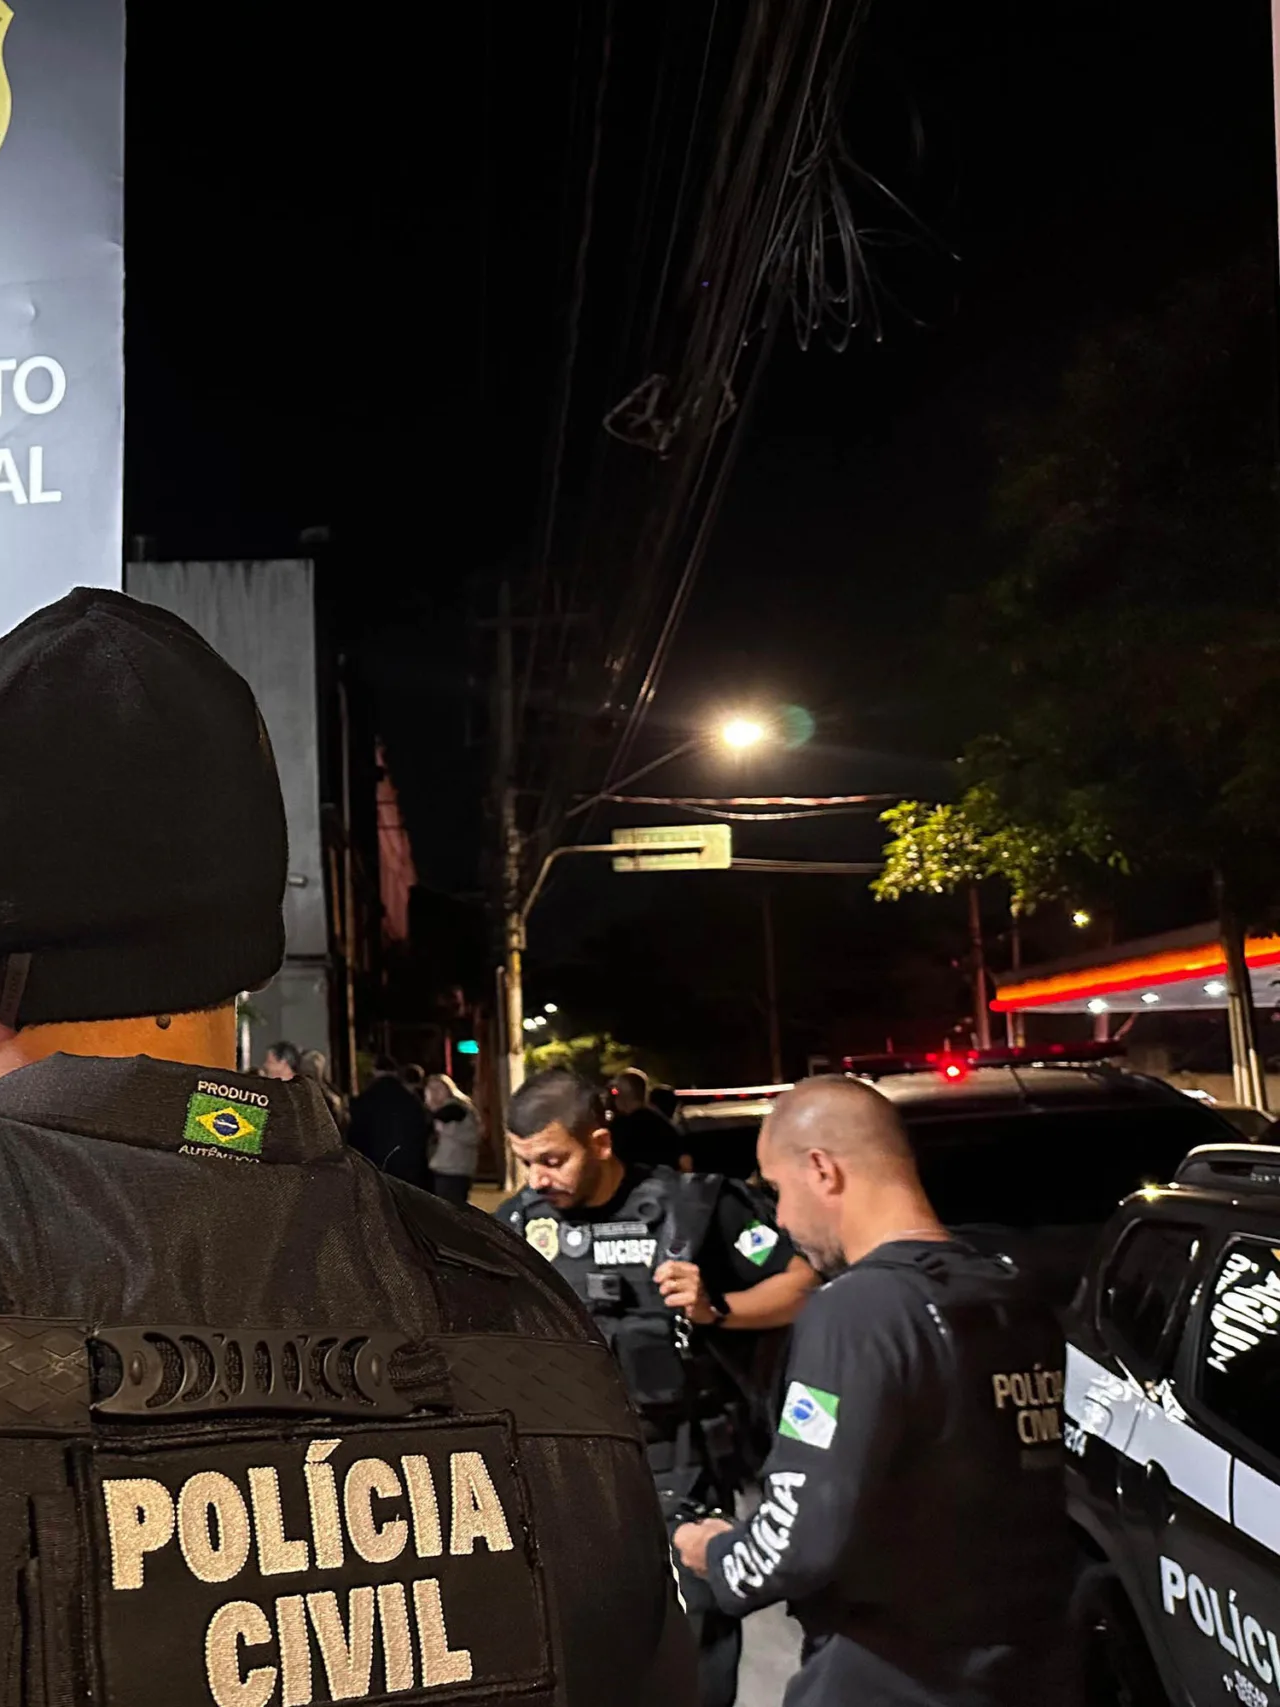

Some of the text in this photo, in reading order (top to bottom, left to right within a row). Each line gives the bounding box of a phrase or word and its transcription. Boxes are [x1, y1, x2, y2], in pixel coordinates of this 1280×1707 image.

[197, 1080, 269, 1107] PRODUTO
[102, 1438, 514, 1590] POLÍCIA
[205, 1578, 473, 1707] CIVIL
[1159, 1555, 1280, 1693] POLÍCI
